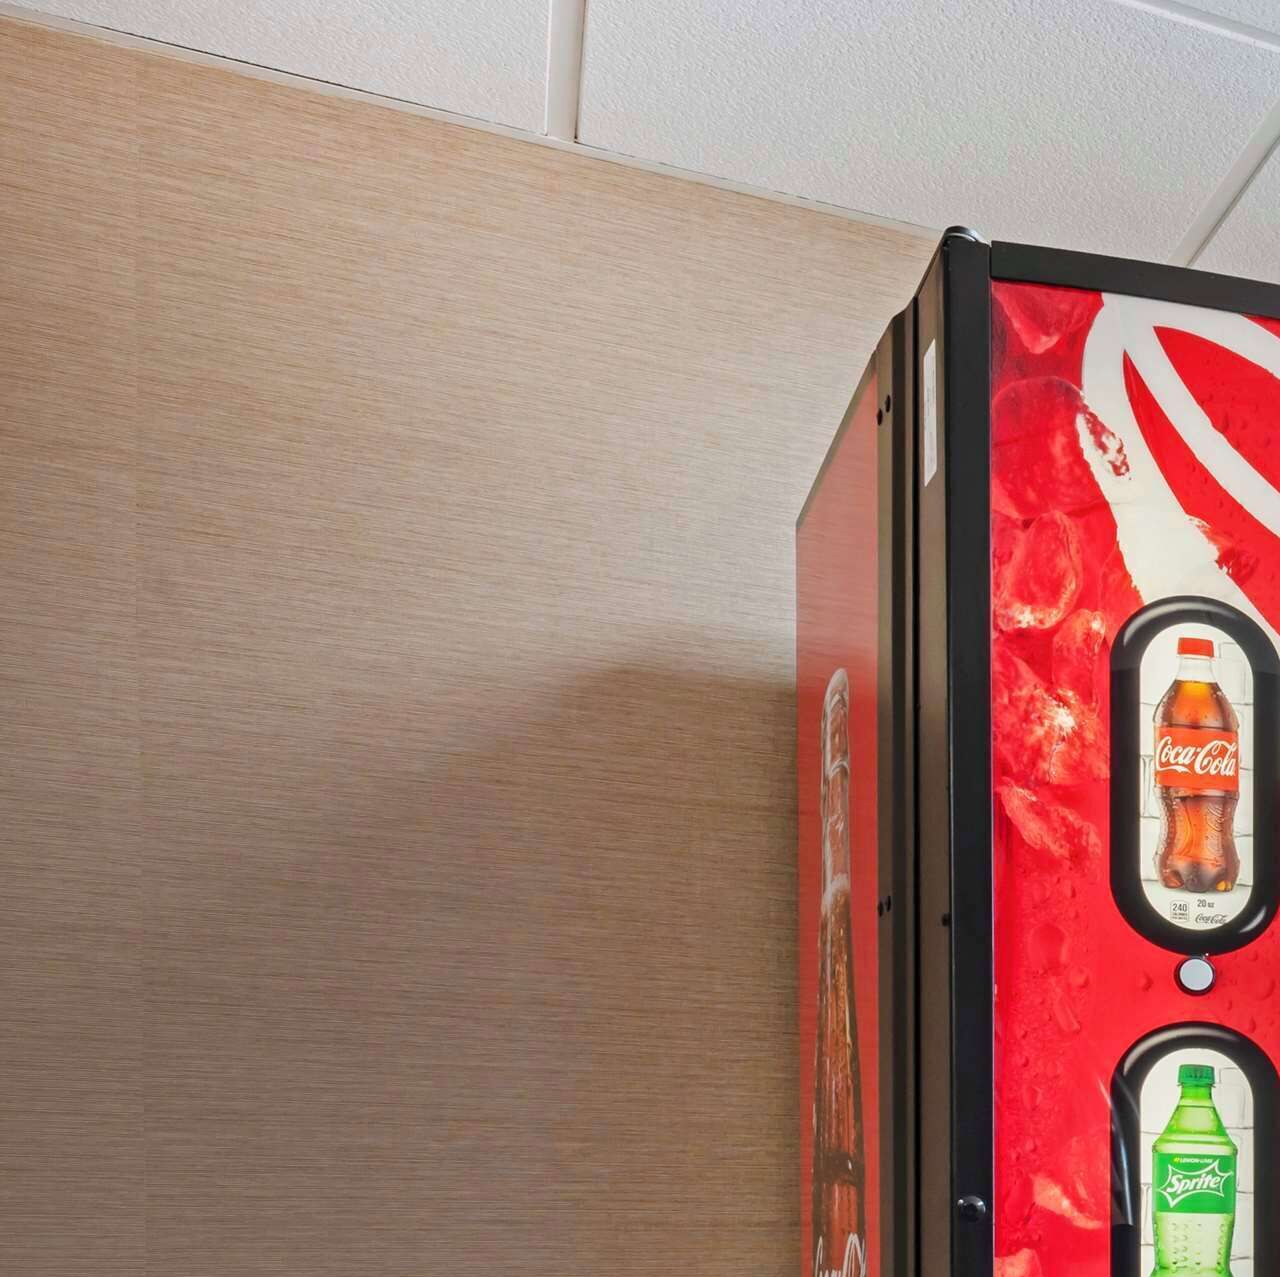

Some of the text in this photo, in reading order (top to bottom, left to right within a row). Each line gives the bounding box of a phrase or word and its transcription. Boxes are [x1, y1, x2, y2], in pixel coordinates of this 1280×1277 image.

[1155, 735, 1238, 777] Coca-Cola
[1172, 903, 1188, 912] 240
[1197, 898, 1207, 908] 20
[1165, 1172, 1222, 1196] Sprite
